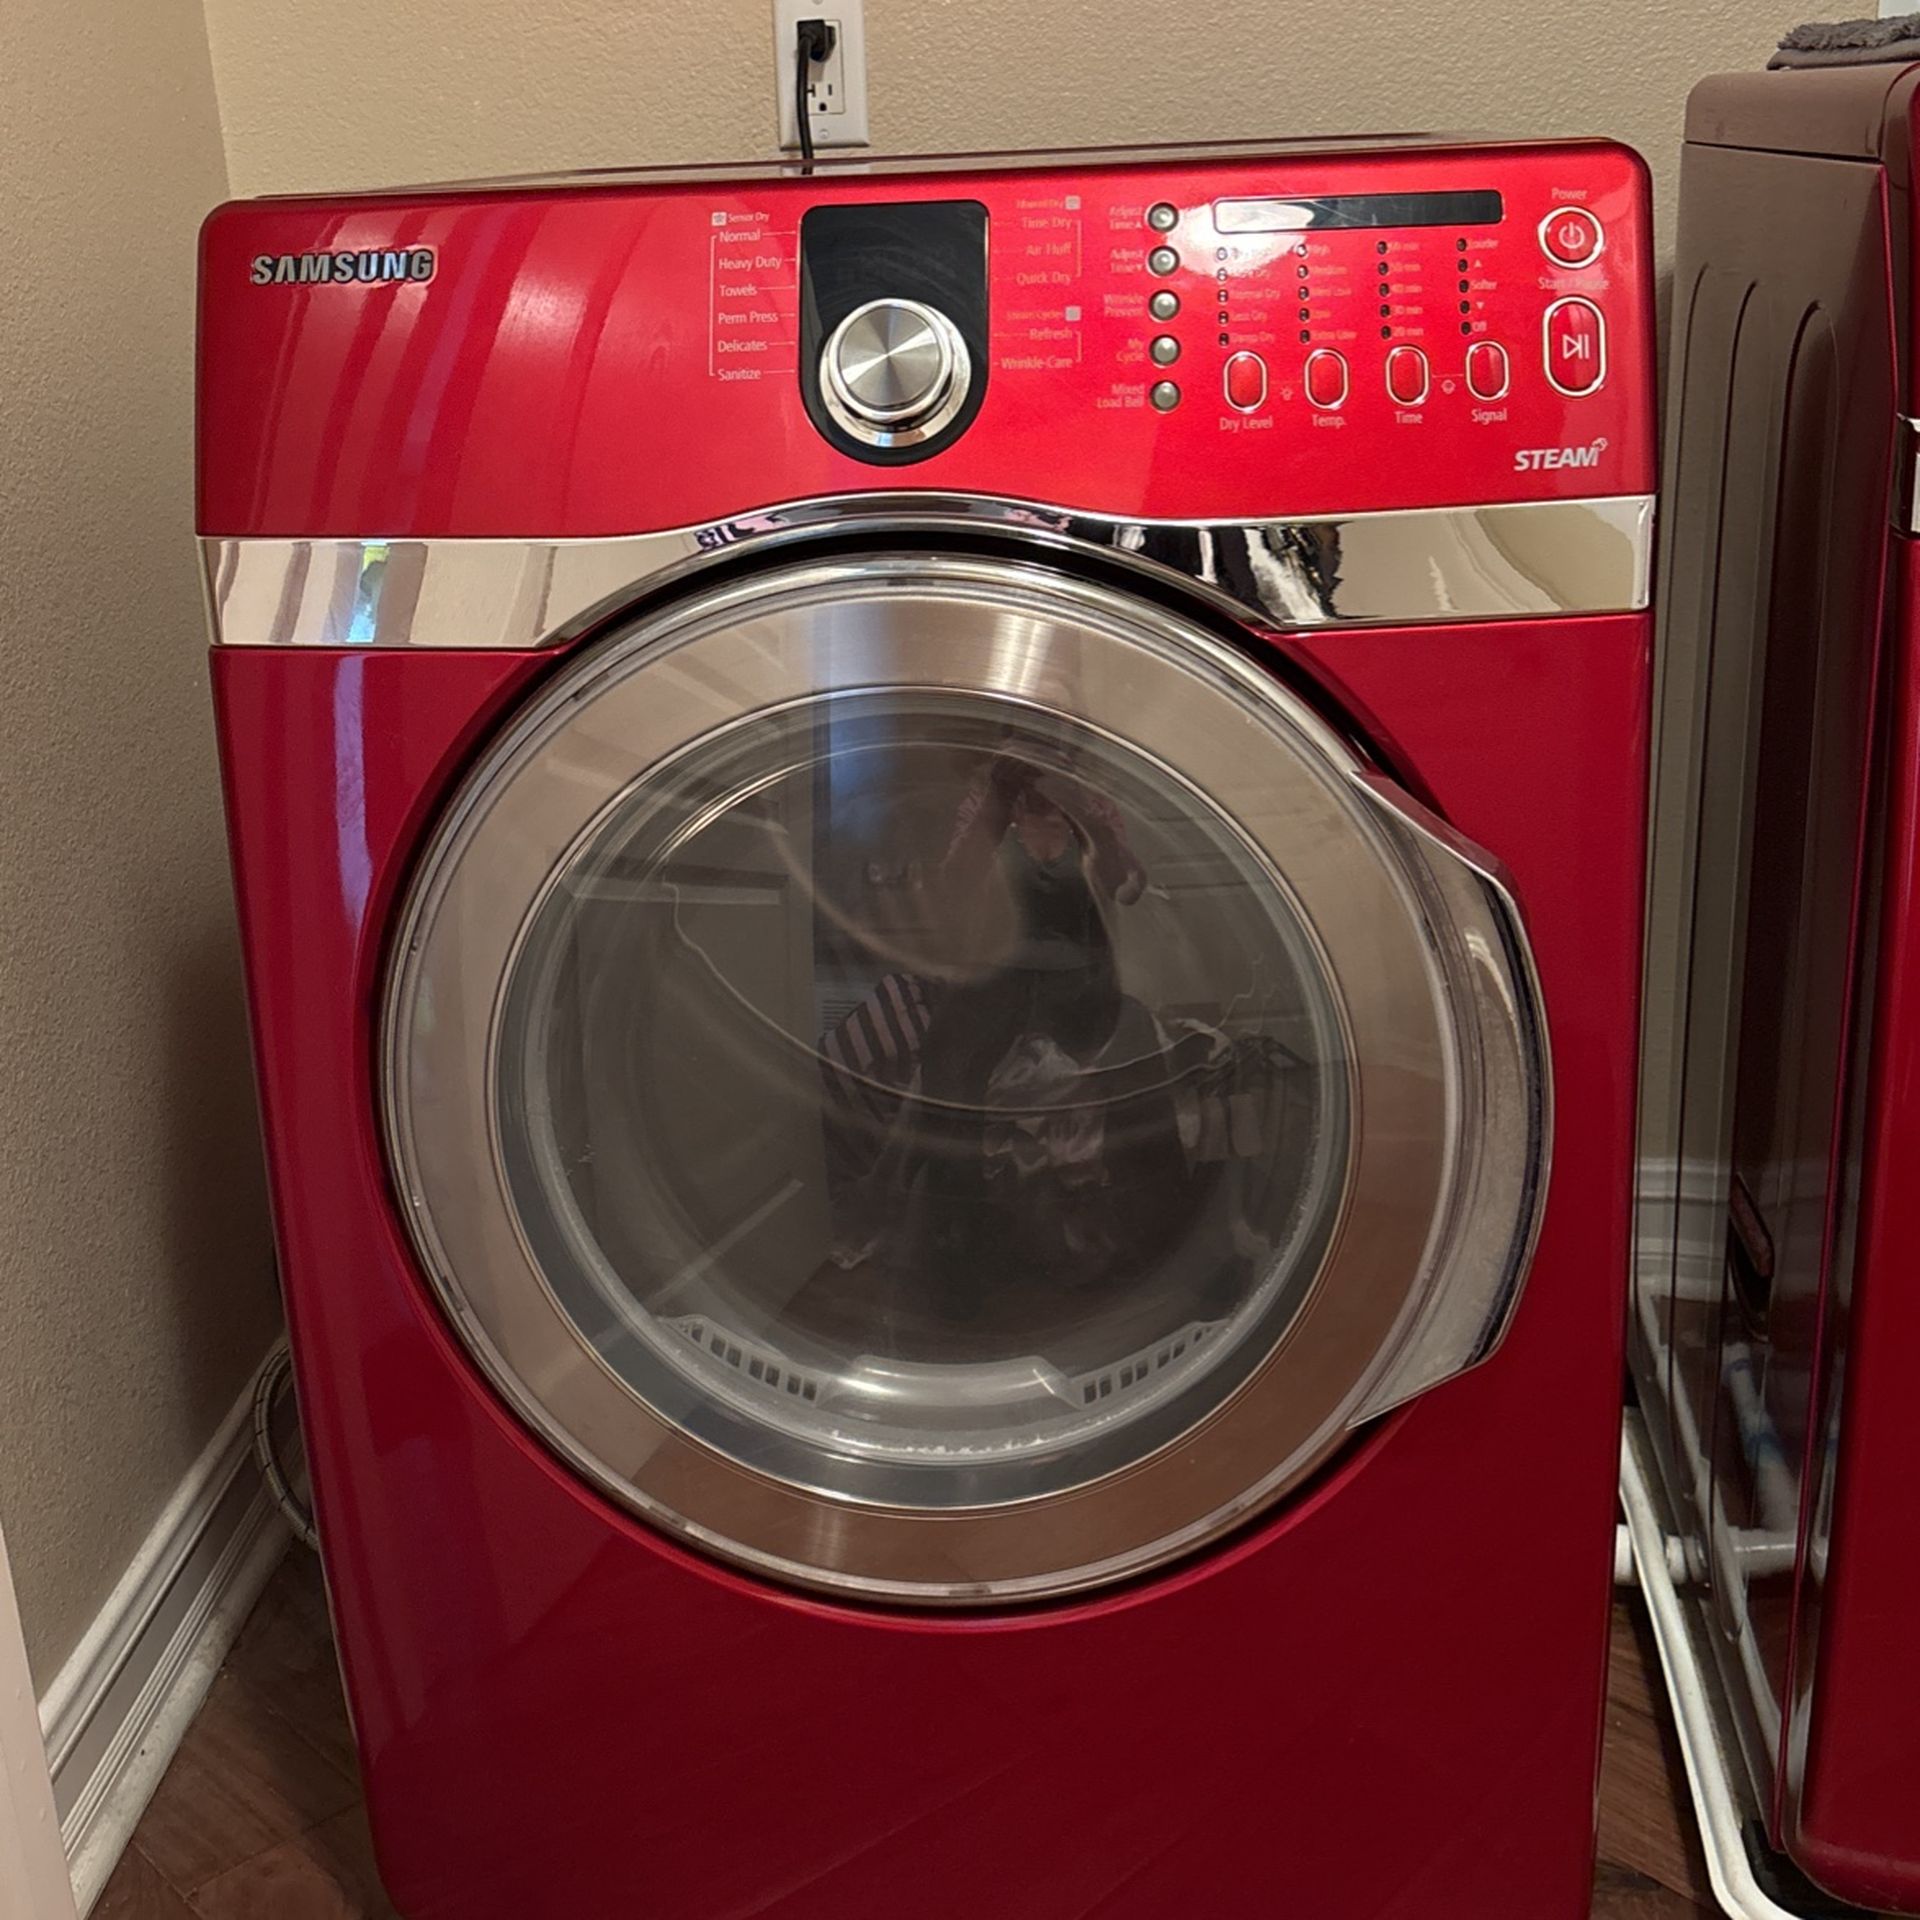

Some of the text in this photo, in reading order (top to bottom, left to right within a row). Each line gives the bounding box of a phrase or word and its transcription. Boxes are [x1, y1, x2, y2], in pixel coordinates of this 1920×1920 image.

[1551, 187, 1588, 200] Power
[755, 211, 770, 223] Dry
[1023, 216, 1072, 230] Time Dry
[719, 230, 761, 243] Normal
[252, 250, 436, 286] SAMSUNG
[718, 255, 782, 271] Heavy Duty
[1016, 271, 1072, 286] Quick Dry
[719, 284, 757, 296] Towels
[718, 311, 778, 324] Perm Press
[1029, 327, 1072, 340] Refresh
[717, 340, 768, 353] Delicates
[717, 368, 762, 380] Sanitize
[1097, 397, 1122, 409] Load
[1395, 410, 1423, 424] Time
[1471, 408, 1507, 425] Signal
[1219, 415, 1273, 434] Dry Level
[1513, 448, 1600, 471] STEAM
